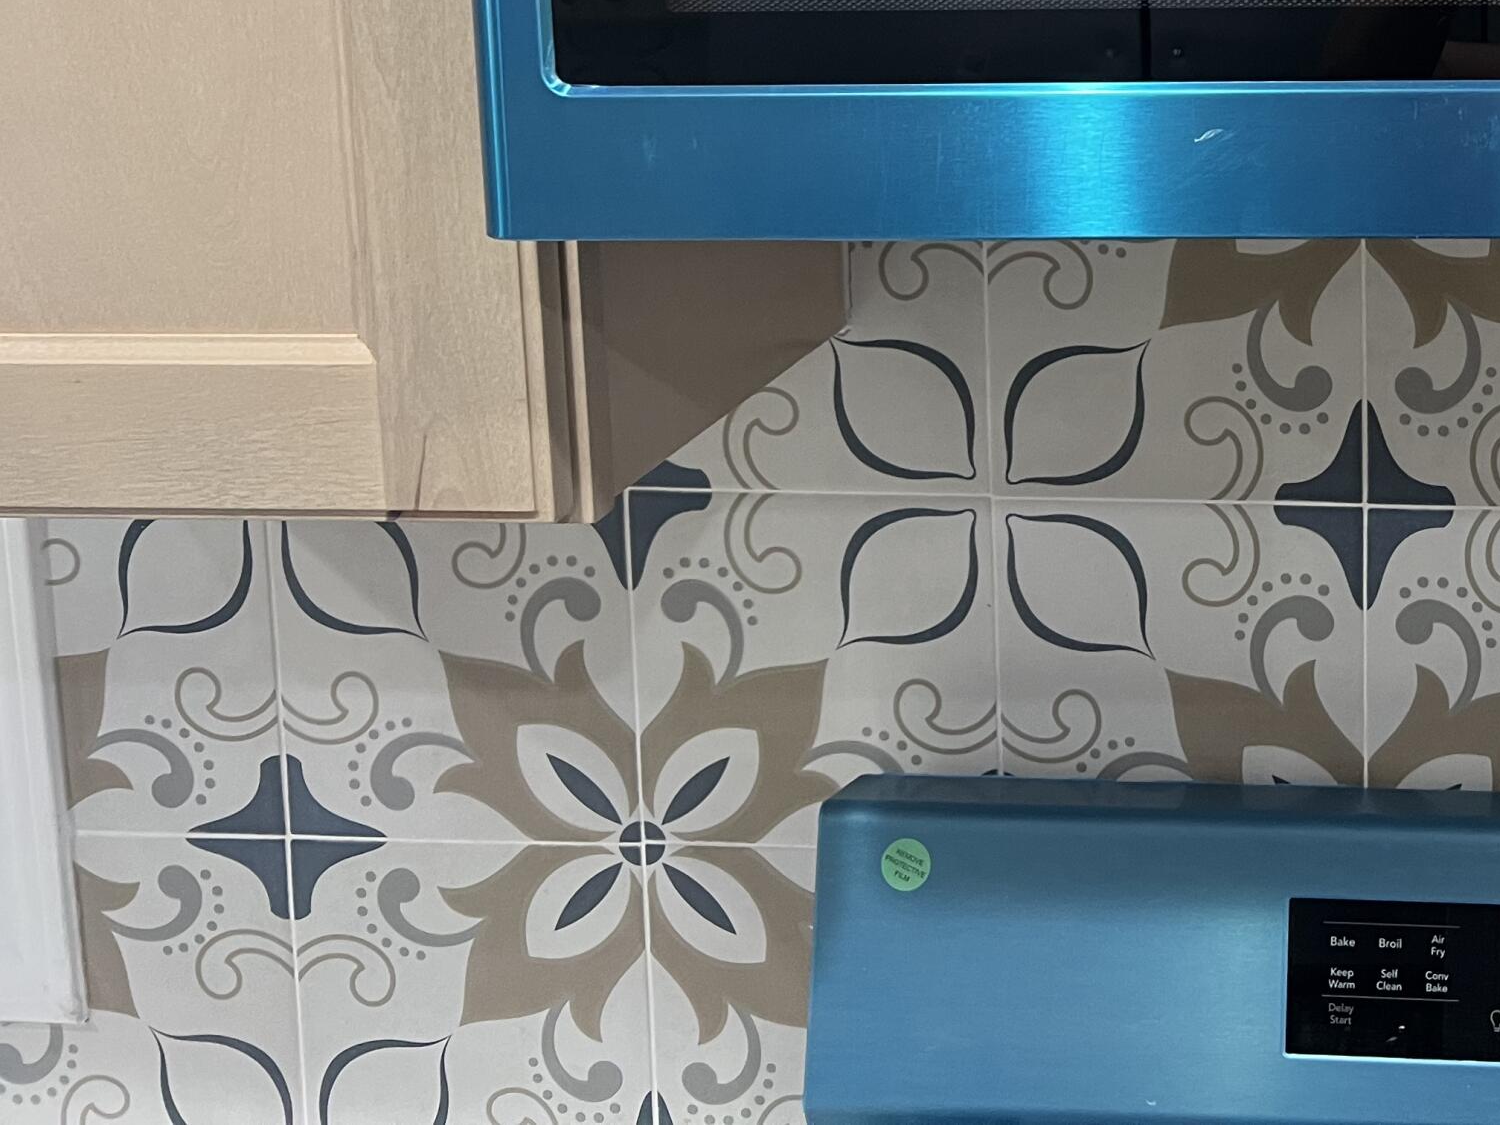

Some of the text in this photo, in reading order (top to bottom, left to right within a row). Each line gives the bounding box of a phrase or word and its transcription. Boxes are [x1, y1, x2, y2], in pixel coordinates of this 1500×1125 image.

[885, 854, 926, 878] PROTECTIVE
[1330, 936, 1355, 947] Bake
[1378, 938, 1402, 949] Broil
[1431, 935, 1445, 944] Air
[1431, 947, 1445, 958] Fry
[1330, 968, 1354, 979] Keep
[1381, 969, 1398, 978] Self
[1425, 971, 1449, 981] Conv
[1329, 979, 1355, 989] Warm
[1376, 981, 1402, 991] Clean
[1425, 983, 1448, 993] Bake
[1328, 1003, 1354, 1014] Delay
[1330, 1015, 1351, 1025] Start
